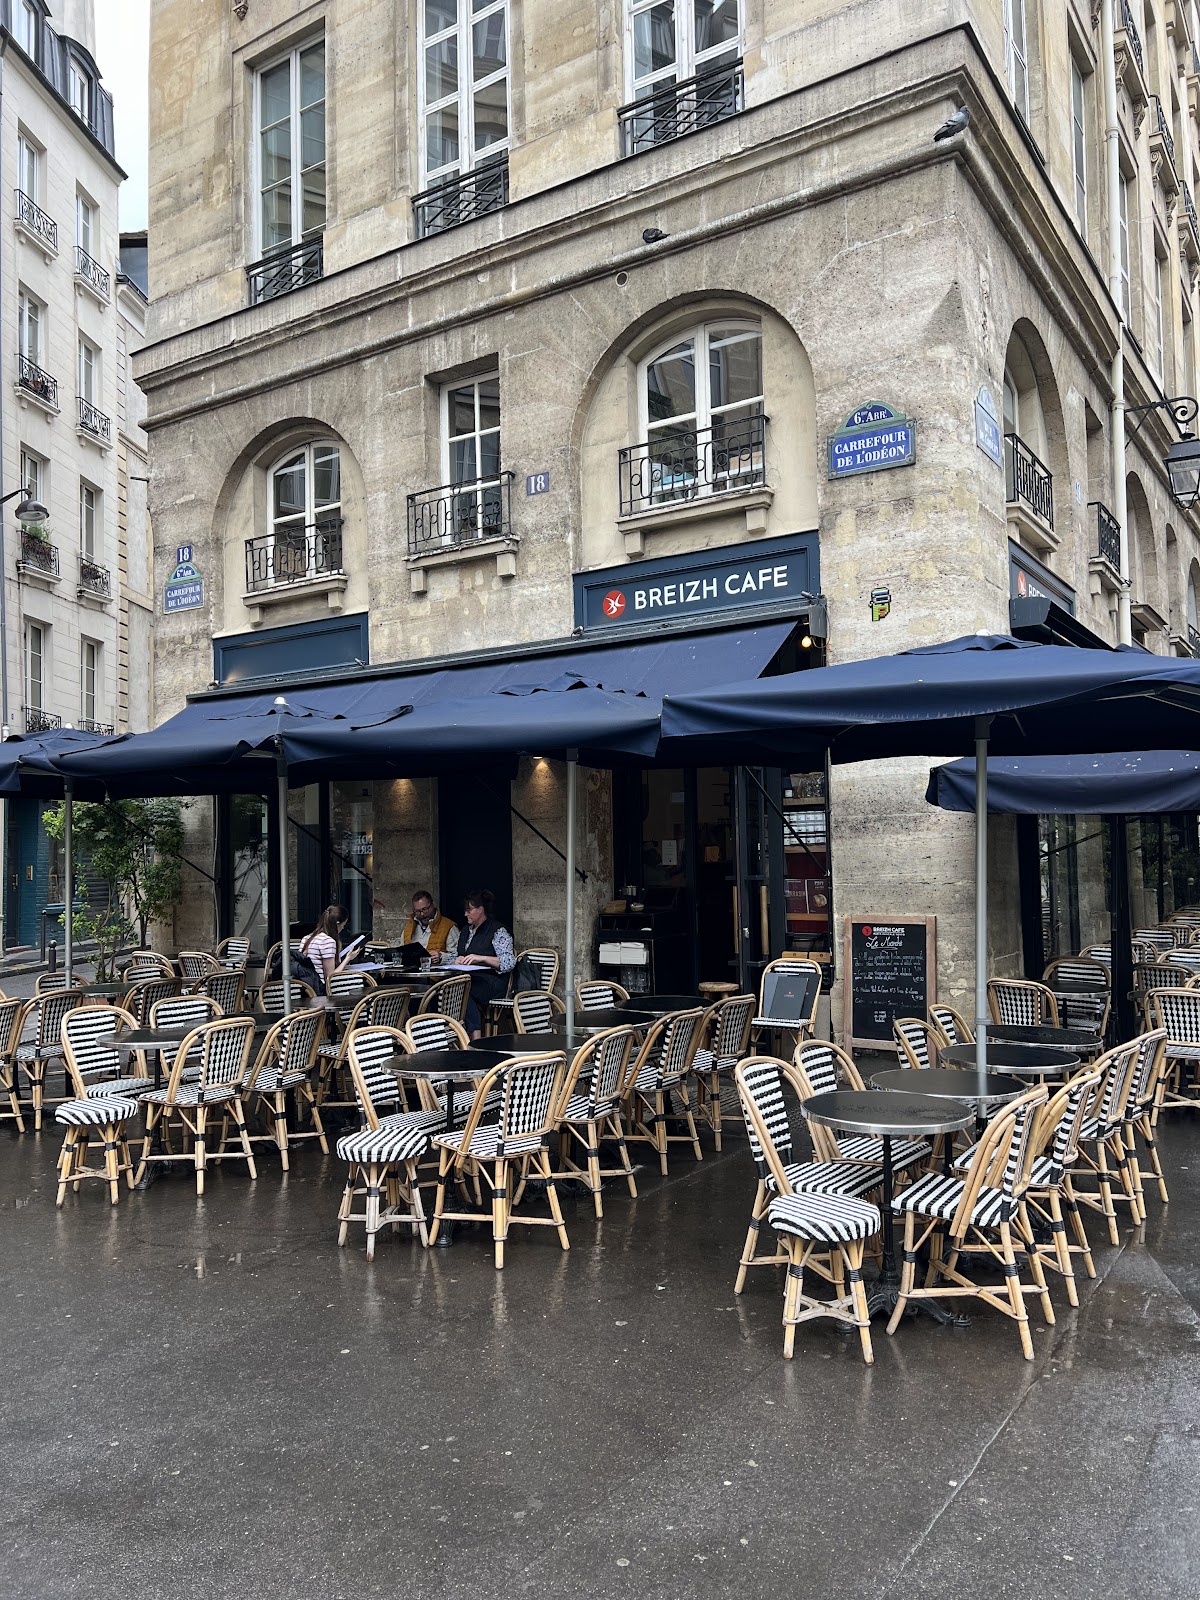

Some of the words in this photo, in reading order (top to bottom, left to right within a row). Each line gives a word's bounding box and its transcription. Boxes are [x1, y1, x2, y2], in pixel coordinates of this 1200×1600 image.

[835, 431, 906, 454] CARREFOUR
[837, 458, 853, 468] DE
[856, 445, 905, 464] L'ODÉON
[530, 475, 545, 493] 18
[179, 547, 189, 562] 18
[167, 585, 200, 598] CARREFOUR
[634, 577, 718, 610] BREIZH
[724, 565, 788, 595] CAFE
[168, 600, 176, 608] DE
